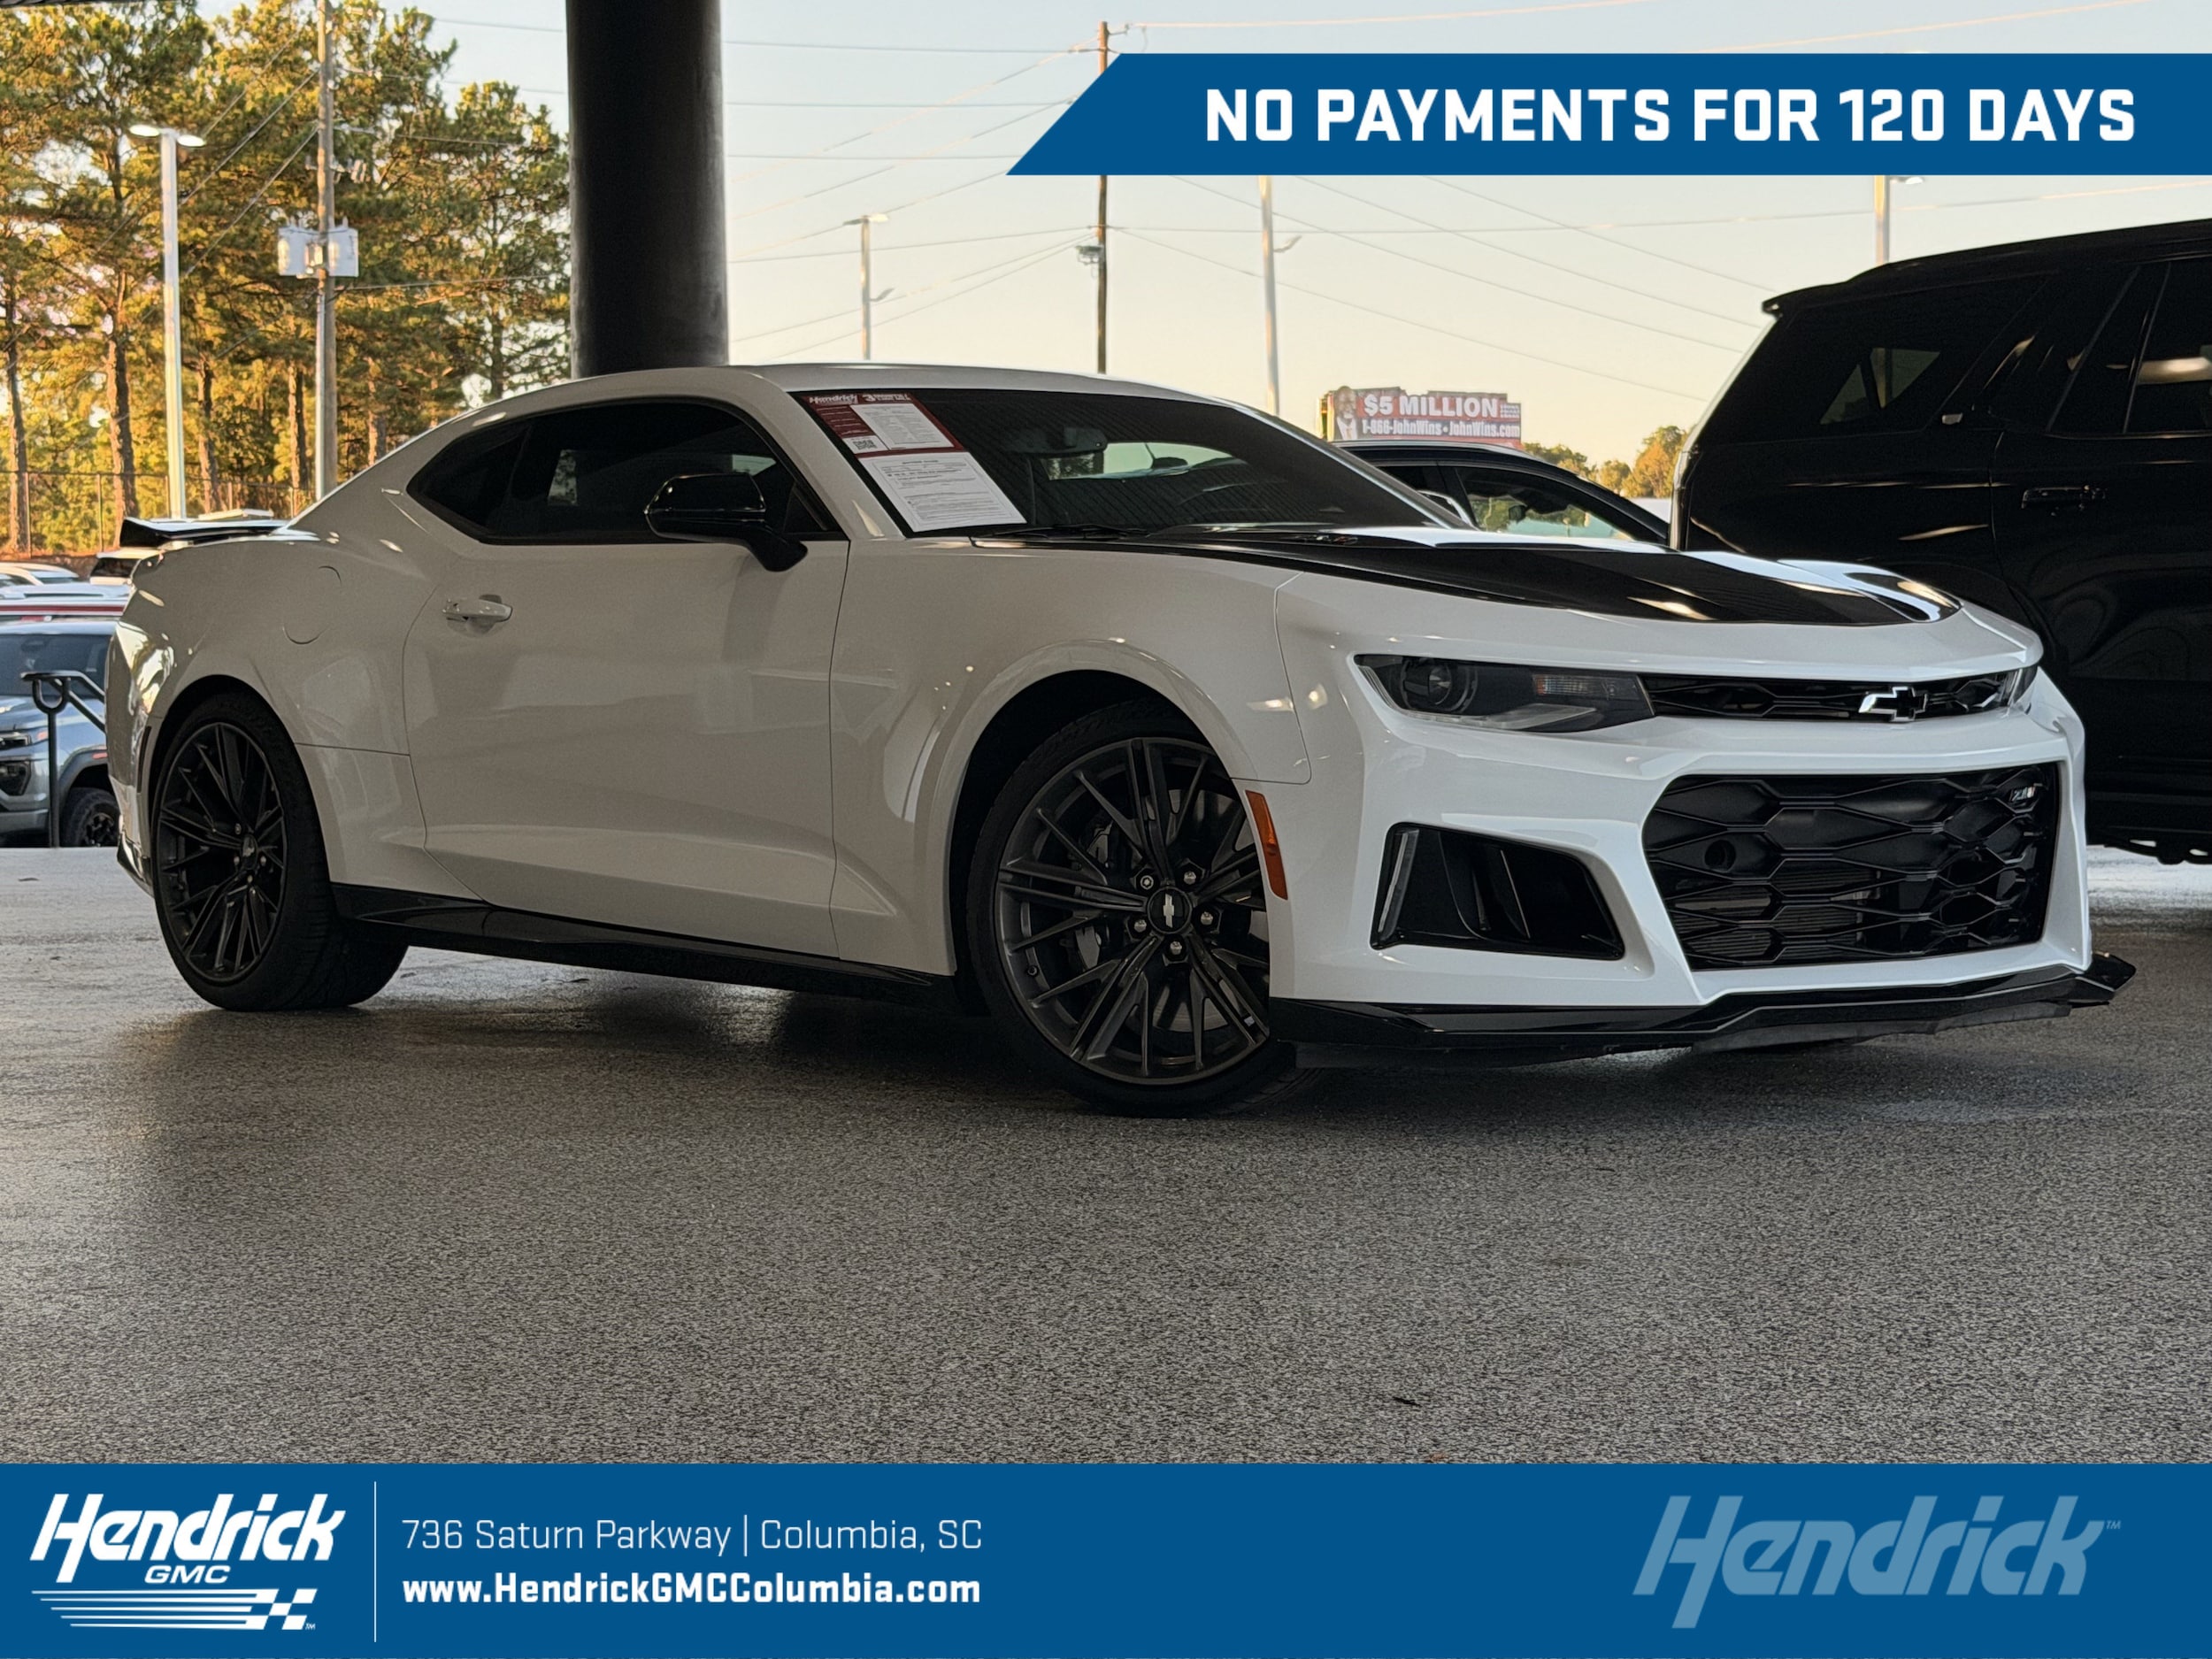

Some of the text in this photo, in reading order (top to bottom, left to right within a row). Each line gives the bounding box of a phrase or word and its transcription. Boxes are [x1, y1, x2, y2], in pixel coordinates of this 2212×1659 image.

[1363, 394, 1394, 416] $5
[1399, 396, 1498, 419] MILLION
[1448, 420, 1520, 438] JohnWins.com
